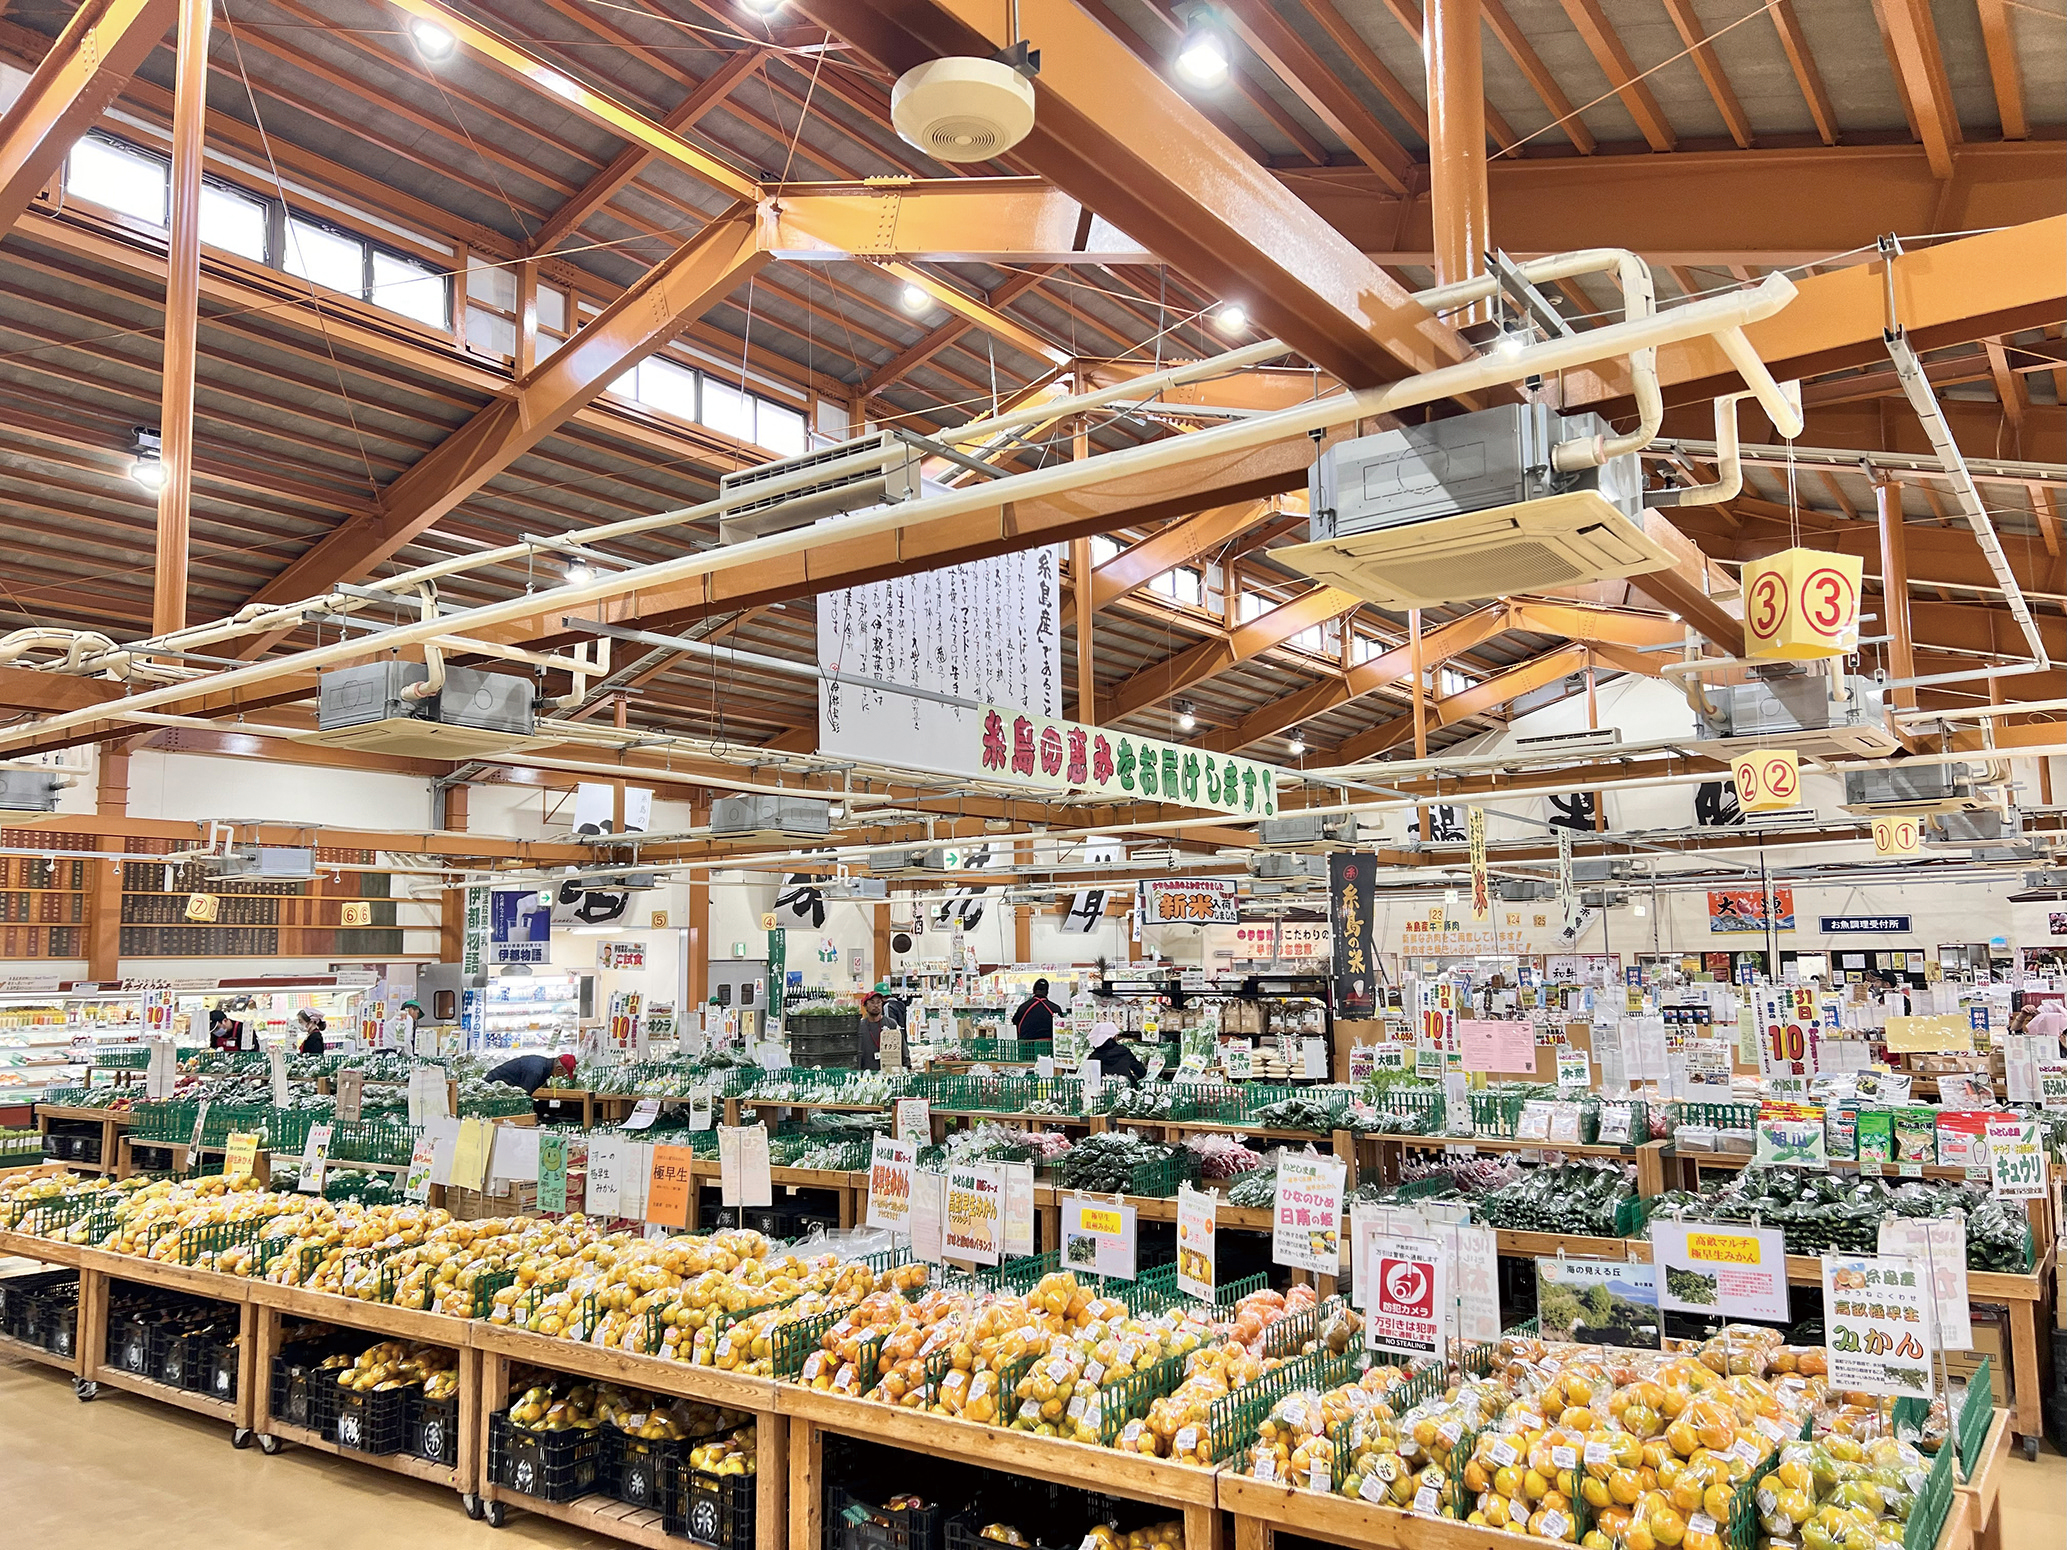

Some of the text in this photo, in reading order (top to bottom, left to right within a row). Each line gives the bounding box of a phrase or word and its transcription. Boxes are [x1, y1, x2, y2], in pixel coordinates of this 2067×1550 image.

[1814, 576, 1841, 628] 3
[1772, 764, 1788, 792] 2
[1159, 893, 1231, 920] 新米 入荷
[1214, 911, 1236, 921] しました
[1342, 883, 1366, 974] 糸島の米
[1830, 919, 1900, 930] お魚調理受付所
[498, 948, 542, 962] 伊都物語
[615, 953, 644, 966] ご試食
[648, 1018, 672, 1032] オクラ
[1378, 1054, 1401, 1066] 大根葉
[1561, 1068, 1587, 1080] 水菜
[653, 1164, 688, 1183] 極早生
[1997, 1154, 2041, 1185] キュウリ
[595, 1183, 618, 1194] みかん
[1282, 1188, 1335, 1209] ひなのひめ
[1280, 1207, 1334, 1227] 日南の姫
[1690, 1247, 1757, 1263] 極早生みかん
[1566, 1264, 1622, 1277] 海の見える丘
[1866, 1268, 1917, 1288] 糸島産
[1382, 1301, 1429, 1317] 防犯カメラ
[1374, 1315, 1438, 1335] 万引きは犯罪
[1385, 1337, 1427, 1351] NO STEALING
[1832, 1324, 1924, 1360] みかん
